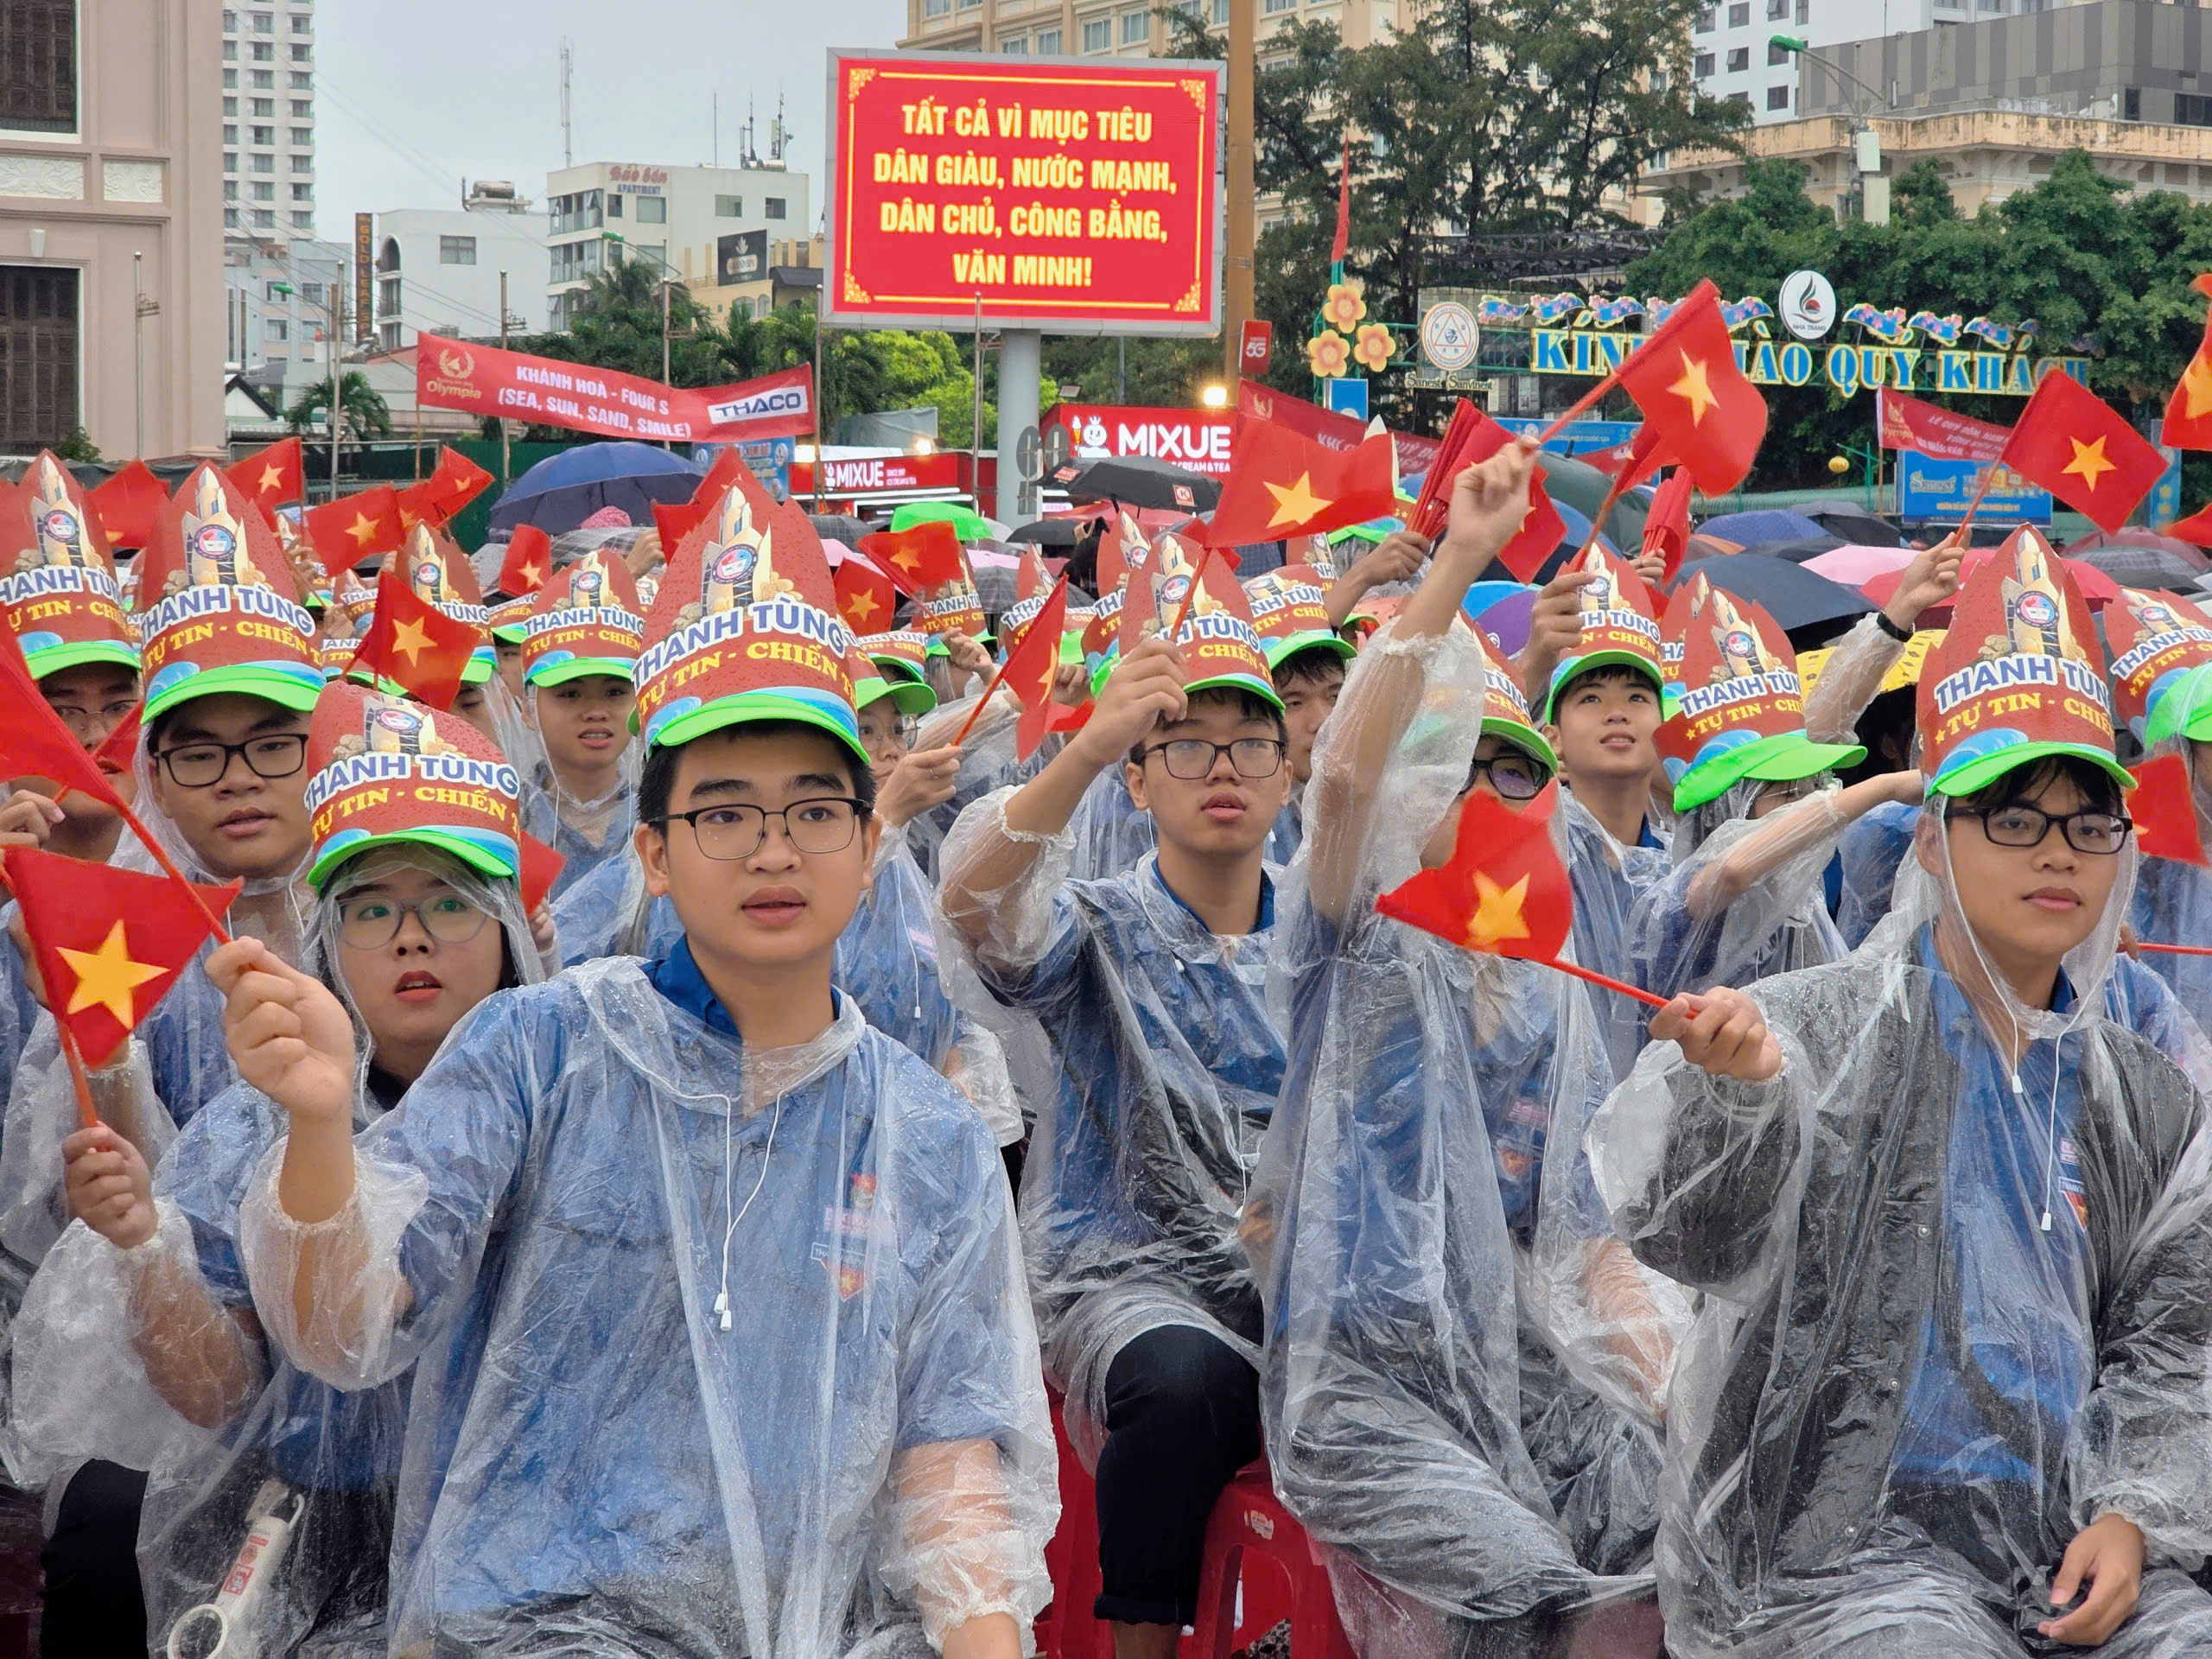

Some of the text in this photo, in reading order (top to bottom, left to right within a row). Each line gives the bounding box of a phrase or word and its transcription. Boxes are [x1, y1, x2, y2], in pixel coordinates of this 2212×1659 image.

[901, 95, 1153, 145] TẤT CẢ VÌ MỤC TIÊU
[617, 184, 662, 194] APARTMENT
[874, 148, 1178, 196] DÂN GIÀU, NƯỚC MẠNH,
[880, 195, 1167, 244] DÂN CHỦ, CÔNG BẰNG,
[359, 226, 371, 264] GOLD
[952, 248, 1093, 287] VĂN MINH!
[1531, 310, 1654, 375] KÍN
[1827, 328, 1921, 398] QUÝ
[427, 380, 482, 399] Olympia
[517, 365, 572, 390] KHÁNH
[576, 377, 608, 398] HOÀ
[621, 388, 656, 411] FOUR
[659, 400, 669, 415] S
[1406, 372, 1494, 391] Sanest Sanvinest
[498, 387, 691, 438] (SEA, SUN, SAND, SMILE)
[715, 392, 801, 416] THACO
[1118, 423, 1231, 459] MIXUE
[836, 461, 884, 487] MIXUE
[0, 567, 82, 605] HANH
[1283, 585, 1324, 605] TÙN
[28, 601, 72, 620] TIN
[141, 586, 229, 647] THANH
[235, 584, 315, 635] TÙNG
[442, 601, 490, 623] TÙNG
[524, 607, 594, 636] THANH
[943, 615, 963, 629] TIN
[1255, 614, 1281, 632] TIN
[1609, 609, 1660, 642] TÙNG
[146, 638, 166, 669] TỰ
[170, 622, 213, 650] TIN
[237, 621, 307, 655] CHIẾN
[531, 635, 551, 653] TỰ
[555, 630, 585, 644] TIN
[599, 630, 640, 652] CHIẾN
[632, 609, 742, 690] THANH
[749, 594, 845, 657] TÙNG
[1197, 610, 1261, 652] TÙNG
[1608, 631, 1656, 655] CHIẾN
[1198, 644, 1257, 670] CHIẾN
[2111, 631, 2188, 680] THANH
[2133, 664, 2155, 687] TỰ
[2155, 646, 2187, 666] TIN
[639, 675, 667, 715] TỰ
[672, 652, 722, 687] TIN
[747, 642, 837, 681] CHIẾN
[1679, 676, 1765, 716] THANH
[1936, 656, 2110, 713] THANH TÙN
[1695, 710, 1723, 730] TỰ
[1726, 702, 1762, 721] TIN
[1947, 702, 1981, 730] TỰ
[1987, 693, 2041, 716] TIN
[305, 753, 518, 813] THANH TÙNG
[313, 804, 334, 842] TỰ
[339, 788, 389, 817] TIN
[415, 787, 506, 821] CHIẾN
